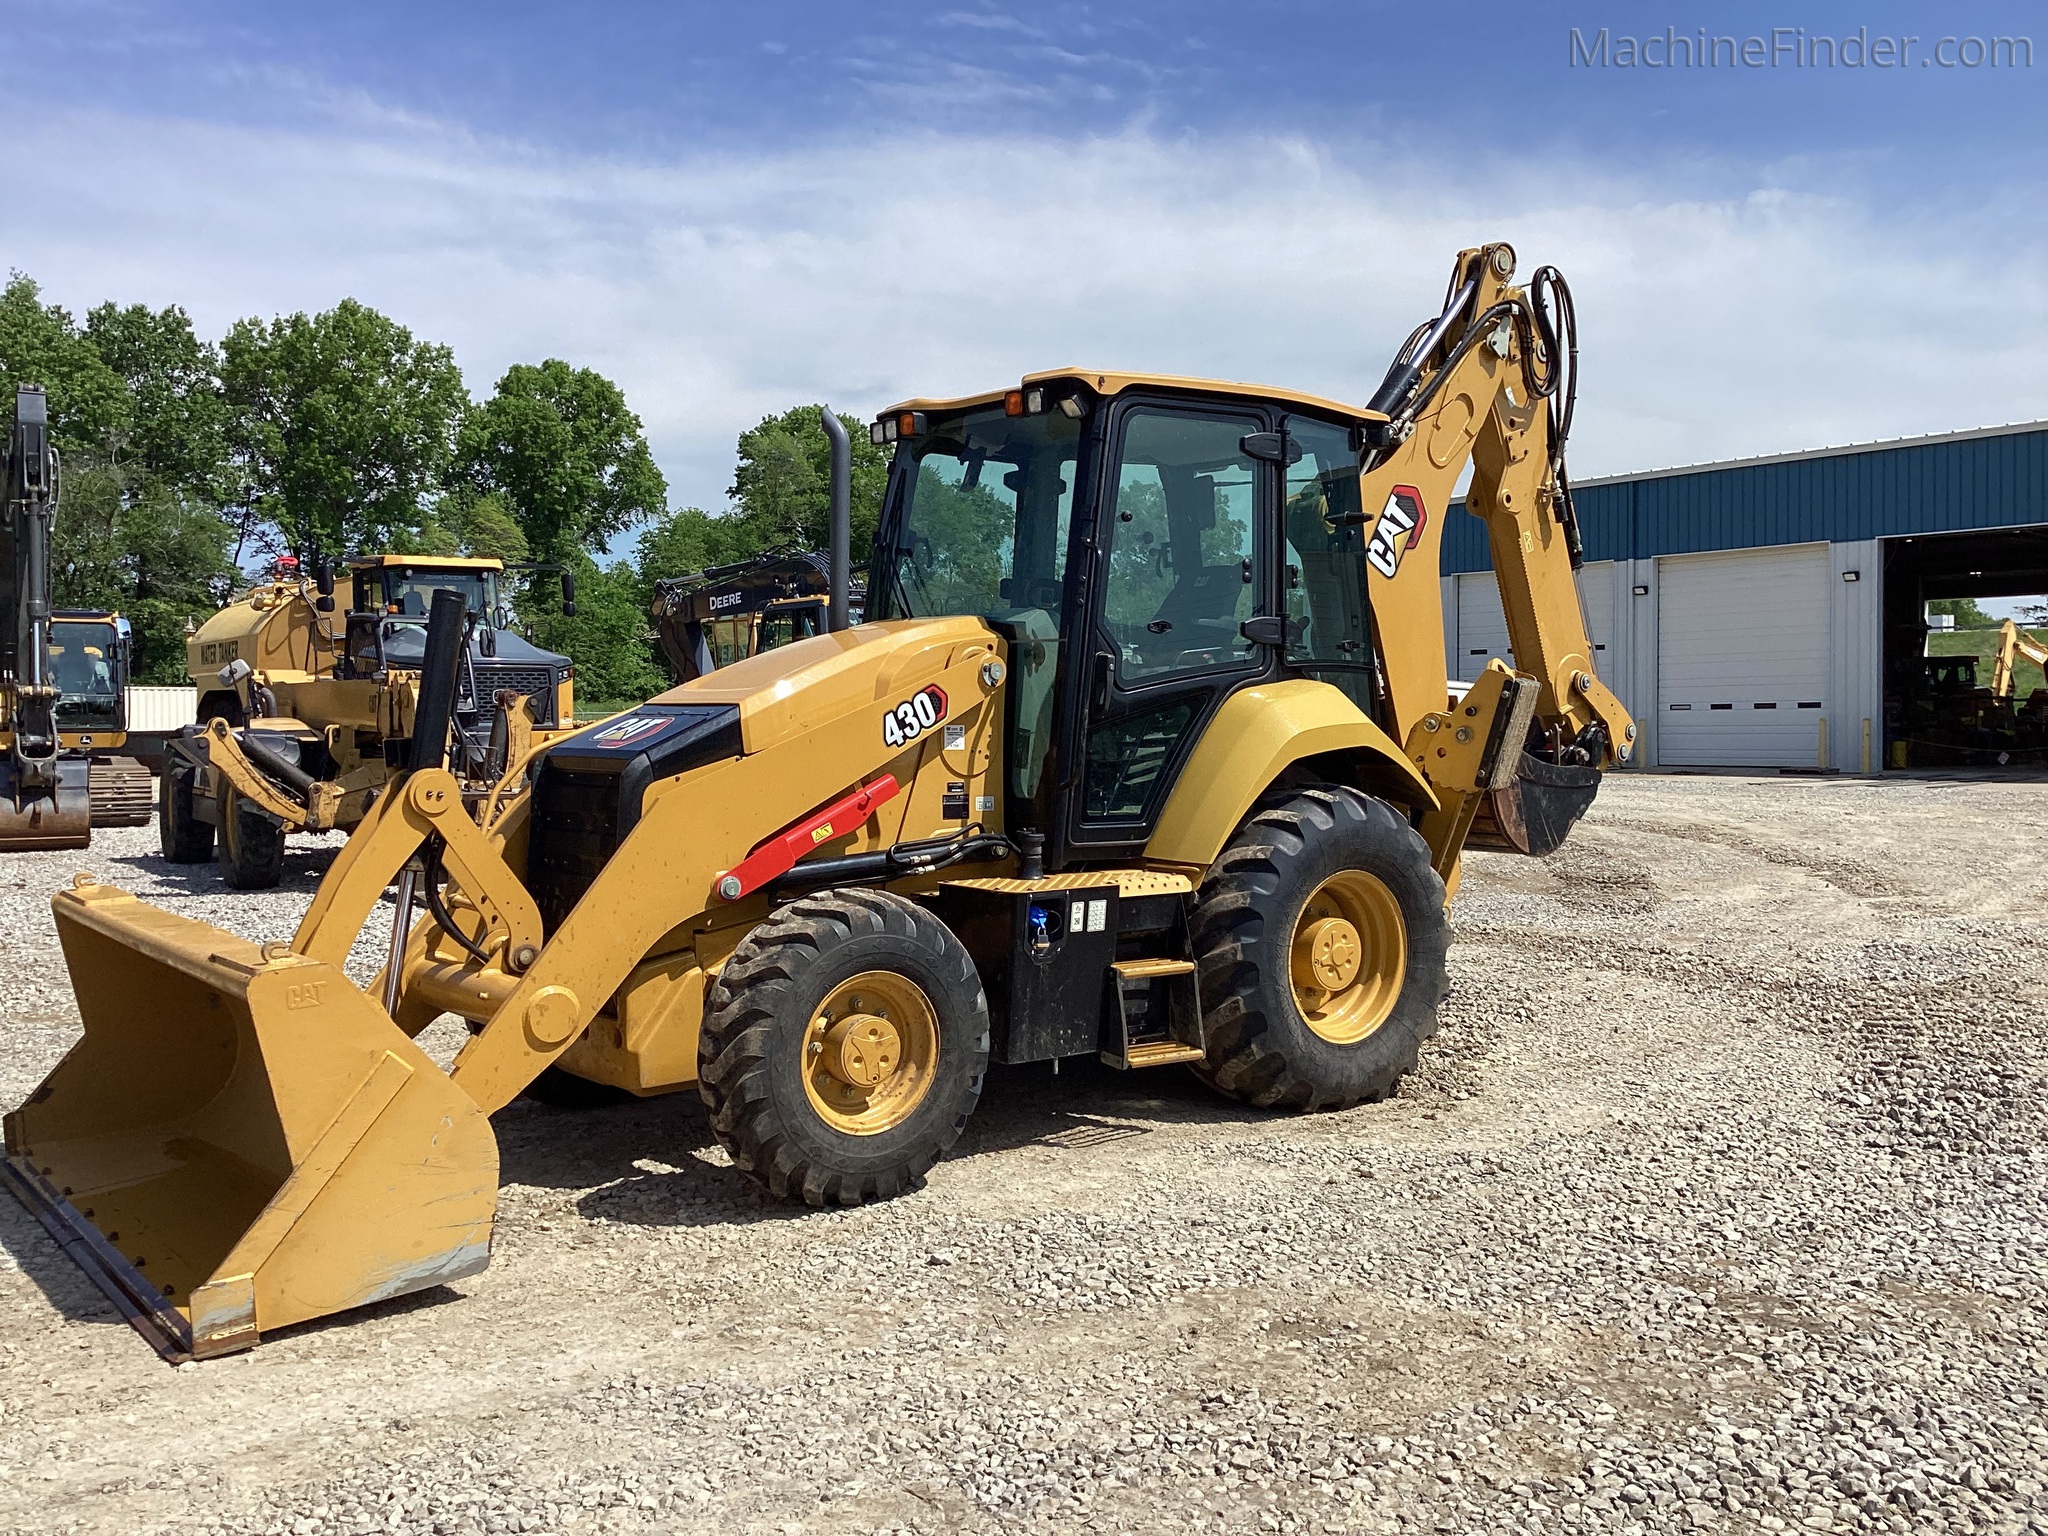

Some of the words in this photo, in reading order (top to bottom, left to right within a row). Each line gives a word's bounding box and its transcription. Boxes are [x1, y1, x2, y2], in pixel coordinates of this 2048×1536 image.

[1367, 492, 1416, 578] CAT
[709, 591, 742, 611] DEERE
[201, 643, 217, 666] WATER
[218, 640, 239, 663] TANKER
[590, 717, 668, 741] CAT
[884, 691, 937, 747] 430
[286, 981, 327, 1010] CAT
